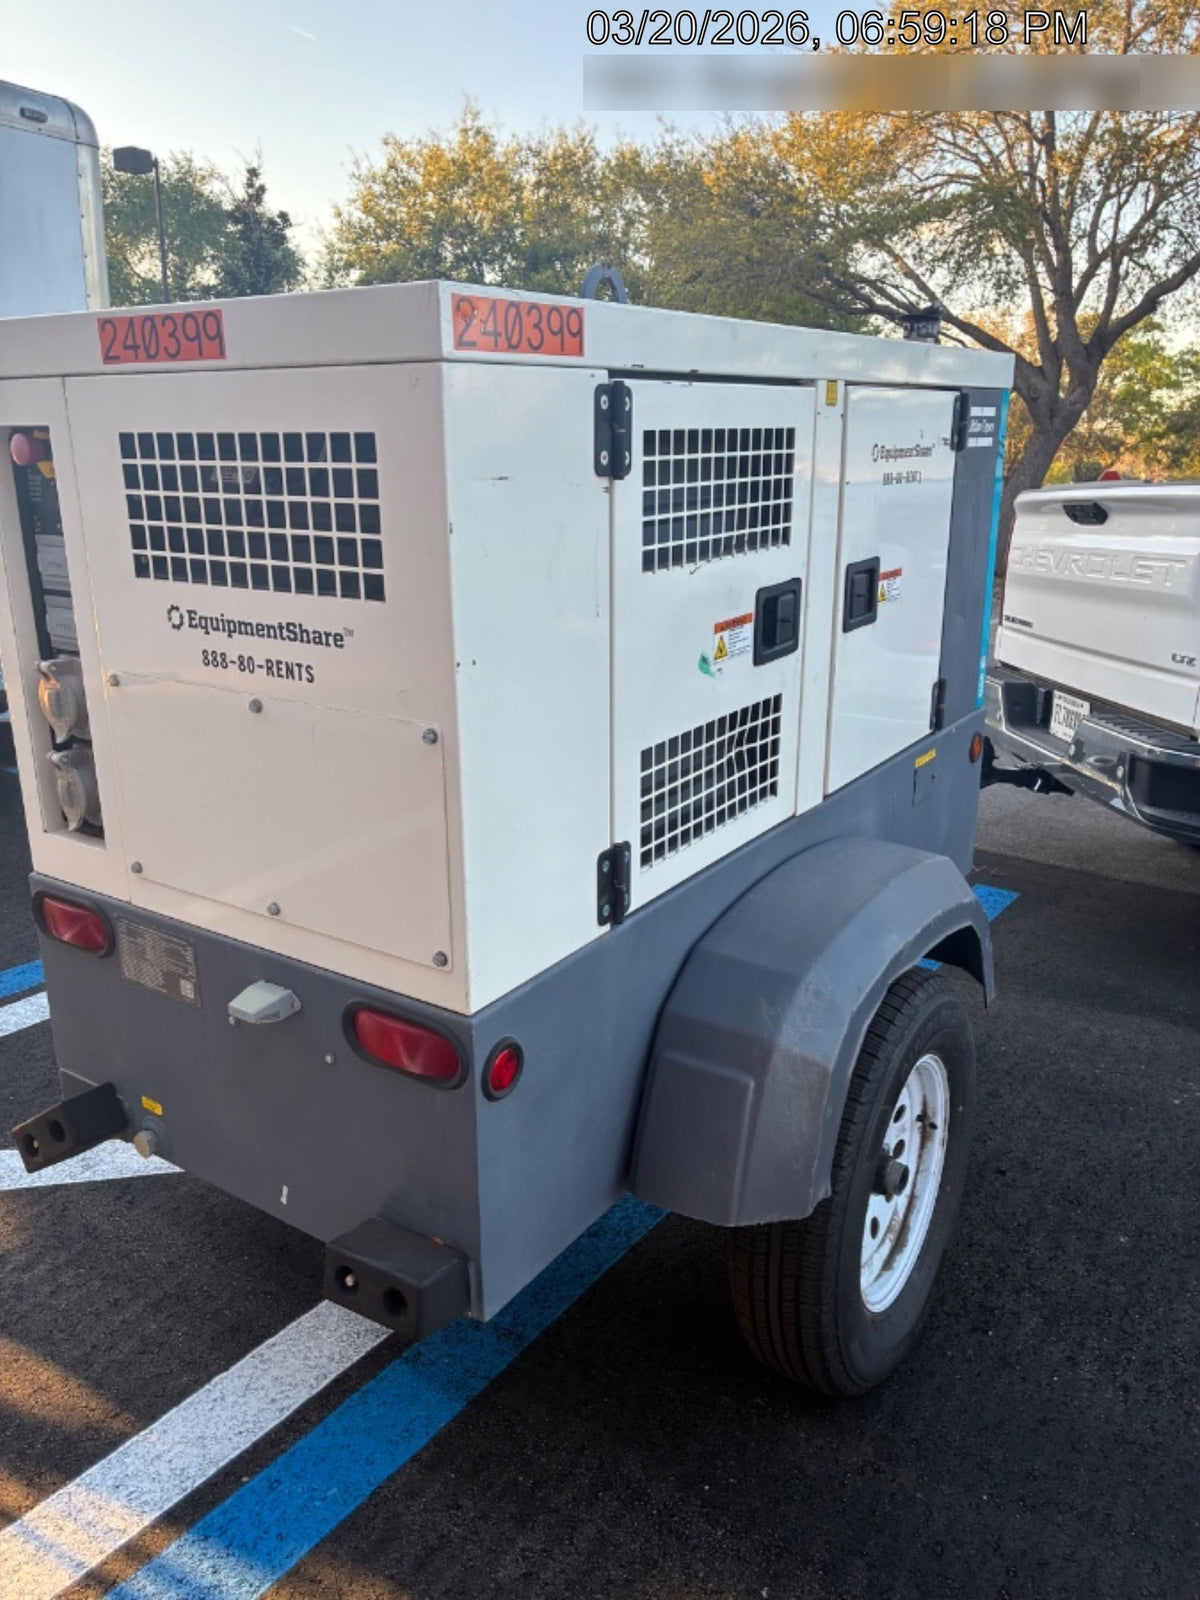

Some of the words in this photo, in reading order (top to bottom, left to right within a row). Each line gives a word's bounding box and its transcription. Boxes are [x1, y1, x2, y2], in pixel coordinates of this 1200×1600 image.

[100, 311, 226, 360] 240399
[456, 296, 584, 353] 240399
[1008, 547, 1187, 586] CHEVROLET
[202, 649, 315, 684] 888-80-RENTS
